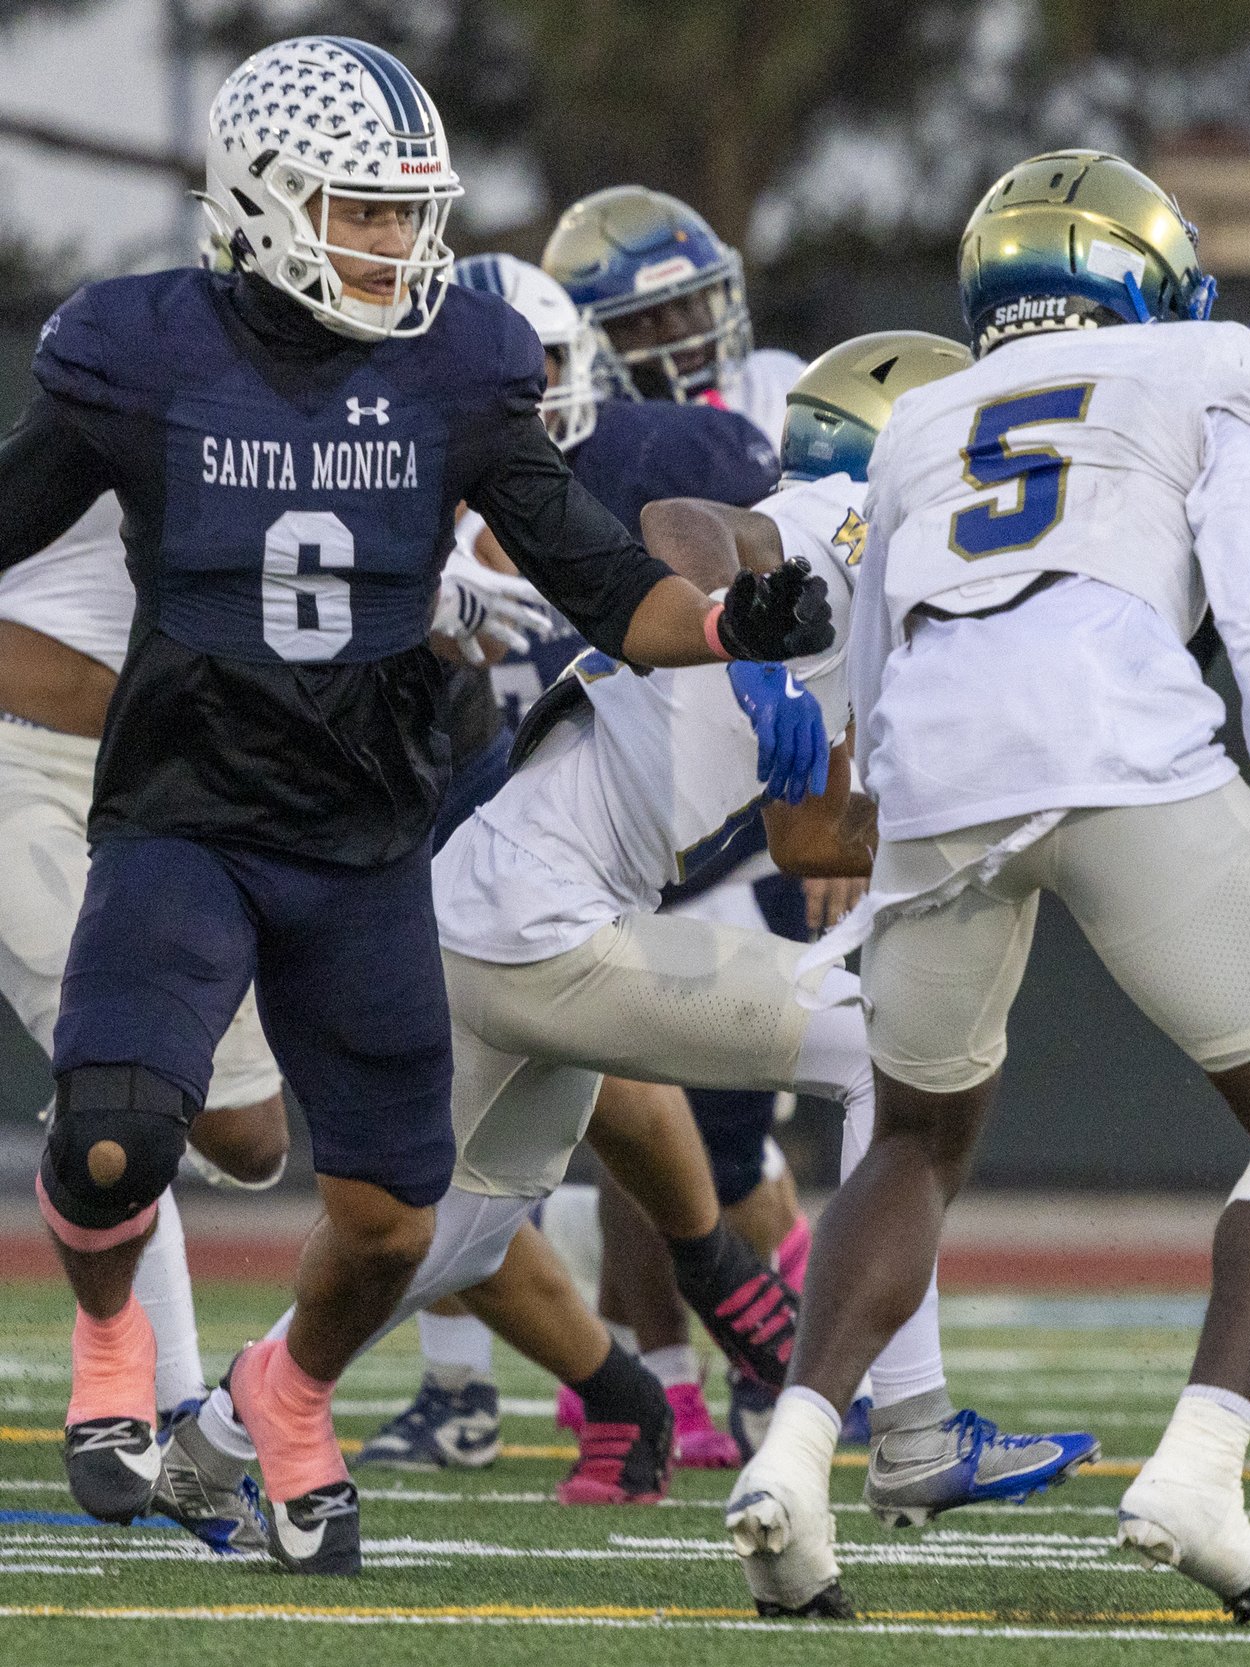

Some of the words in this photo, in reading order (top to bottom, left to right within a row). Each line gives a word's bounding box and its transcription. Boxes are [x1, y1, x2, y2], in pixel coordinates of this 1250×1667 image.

[400, 161, 442, 175] Riddell
[995, 295, 1067, 325] schutt
[202, 436, 297, 490] SANTA
[311, 440, 418, 490] MONICA
[948, 382, 1096, 563] 5
[262, 510, 355, 661] 6
